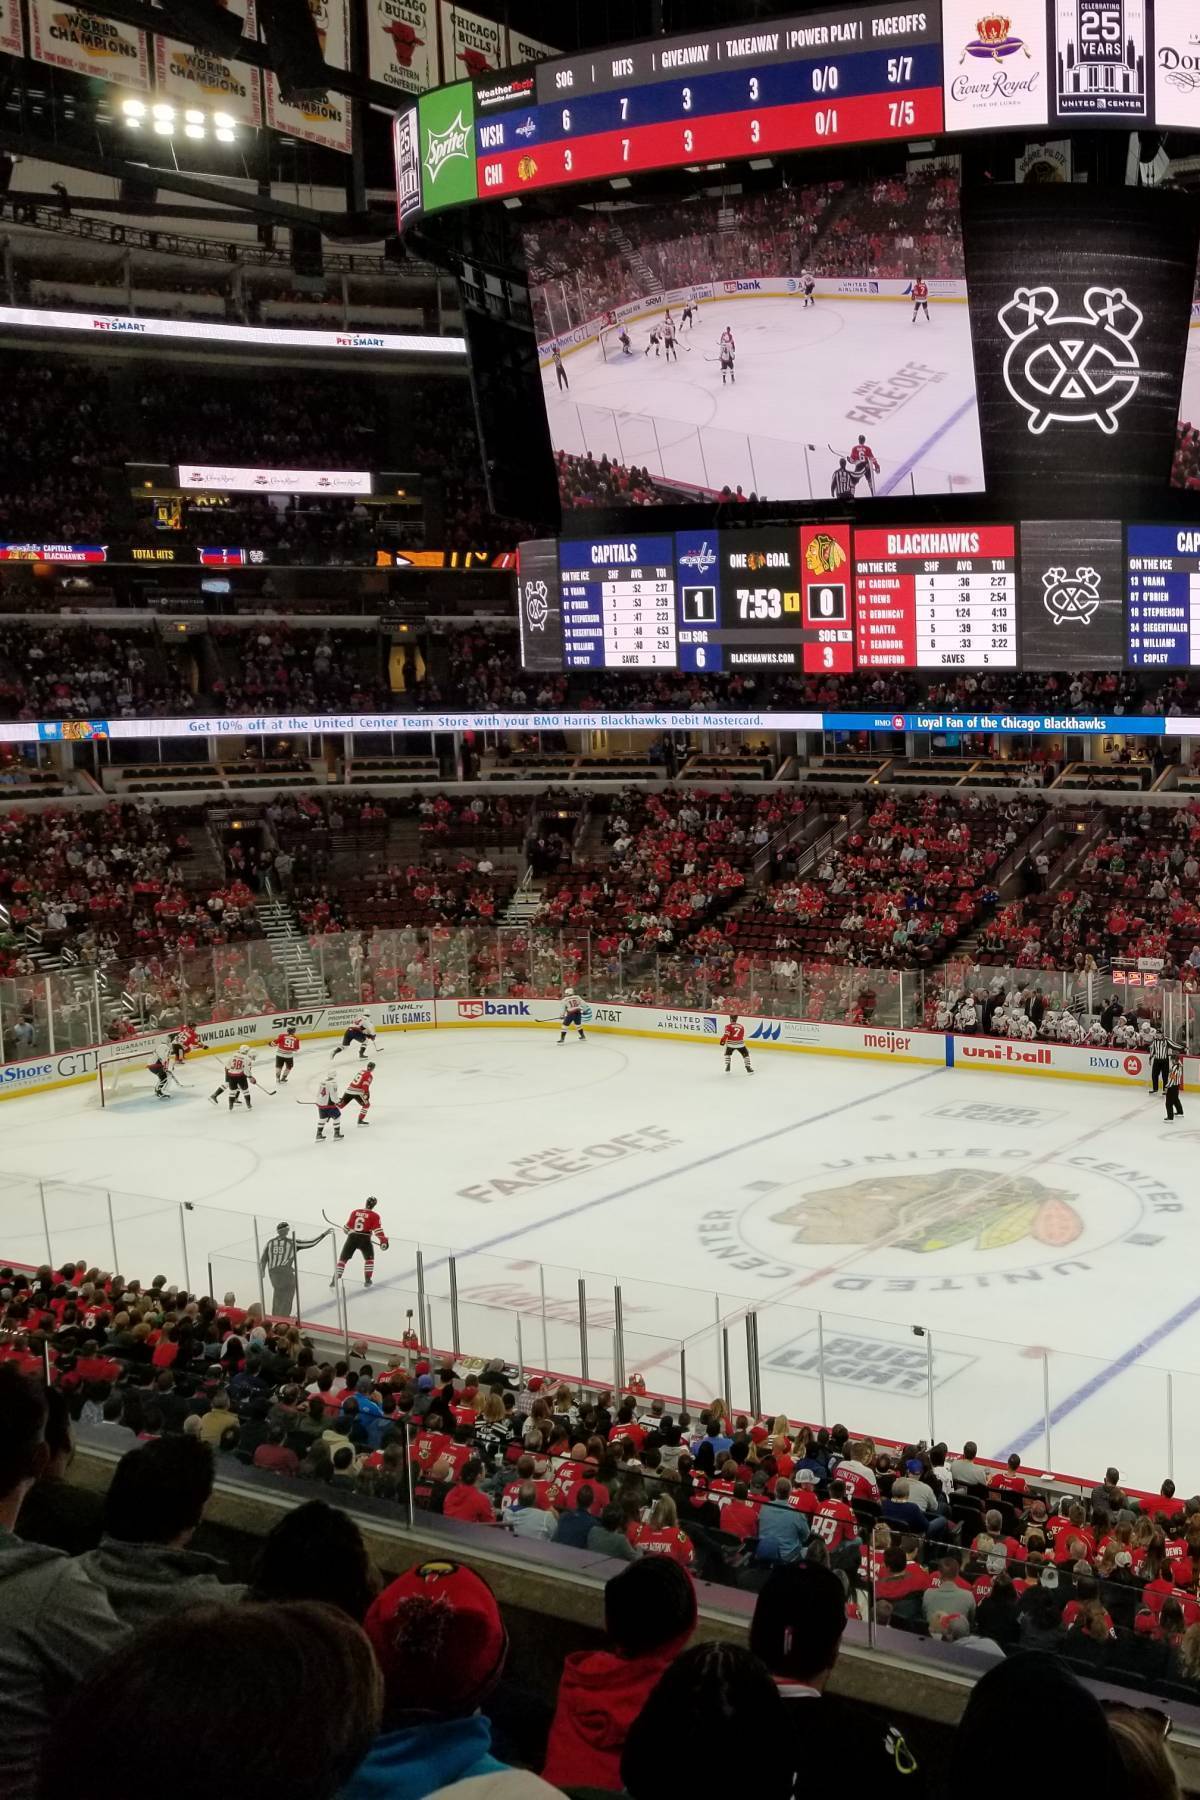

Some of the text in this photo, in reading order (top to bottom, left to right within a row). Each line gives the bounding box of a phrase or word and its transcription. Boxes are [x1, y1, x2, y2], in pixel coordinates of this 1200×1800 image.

[385, 4, 421, 27] BULLS
[66, 15, 118, 38] WORLD
[1081, 11, 1120, 40] 25
[51, 26, 137, 59] CHAMPIONS
[458, 31, 491, 53] BULLS
[556, 14, 926, 88] SOG HITS GIVEAWAY TAKEAWAY POWER PLAY FACEOFFS
[1081, 42, 1121, 55] YEARS
[185, 53, 230, 78] WORLD
[390, 63, 420, 82] EASTERN
[170, 64, 246, 98] CHAMPIONS
[951, 71, 1040, 101] Crown Royal
[480, 56, 913, 148] WSH 0/0 5/7
[1061, 100, 1142, 108] UNITED CENTER
[429, 131, 465, 166] Sprite
[484, 101, 914, 186] CHI 7/5
[93, 318, 146, 333] PETSMART
[336, 336, 384, 347] PETSMART
[845, 361, 937, 426] FACE-OFF
[853, 380, 880, 396] NHL
[887, 533, 979, 554] BLACKHAWKS
[132, 550, 174, 560] TOTAL HITS
[591, 544, 637, 563] CAPITALS
[730, 552, 790, 568] ONE GOAL
[884, 560, 1005, 572] ICE SHF AVG TOI
[1130, 559, 1172, 570] ON THE ICE
[736, 589, 782, 619] 7:53
[731, 653, 795, 664] BLACKHAWKS.COM
[941, 654, 965, 664] SAVES
[189, 714, 764, 732] Get 10% off at the United Center Team Store with your BMO Harris Blackhawks Debit Mastercard.
[918, 716, 1106, 731] Loyal Fan of the Chicago Blackhawks
[272, 1012, 313, 1029] SRM
[381, 1012, 431, 1025] LIVE GAMES
[595, 1009, 622, 1024] AT&T
[665, 1014, 700, 1024] UNITED
[237, 1023, 257, 1036] NOW
[657, 1022, 701, 1031] AIRLINES
[732, 1026, 742, 1037] 7
[283, 1039, 295, 1049] 91
[863, 1031, 912, 1053] meijer
[962, 1044, 1052, 1065] uni-ball
[1089, 1055, 1119, 1069] BMO
[230, 1059, 243, 1069] 38
[320, 1086, 327, 1097] 4
[938, 1108, 1037, 1126] LIGHT
[963, 1102, 1041, 1117] BUD
[456, 1124, 671, 1204] FACE-OFF
[509, 1145, 575, 1168] NHL
[823, 1148, 1184, 1215] UNITED CENTER
[354, 1217, 366, 1232] 6
[272, 1245, 285, 1255] 89
[700, 1209, 1092, 1292] UNITED CENTER
[821, 1338, 936, 1367] BUD
[768, 1351, 936, 1389] LIGHT
